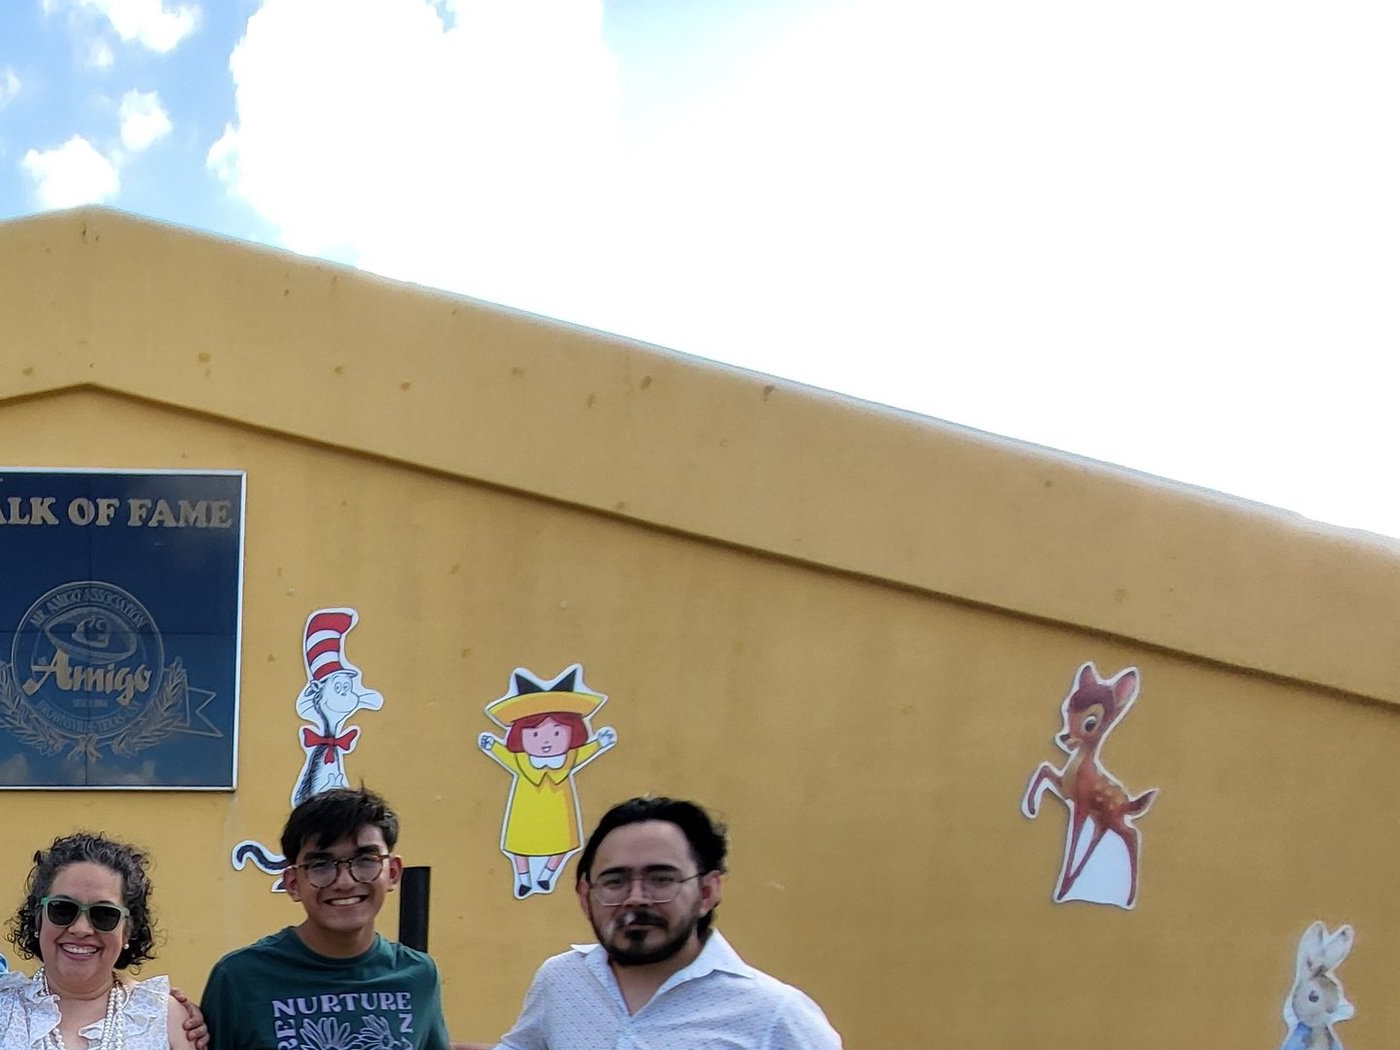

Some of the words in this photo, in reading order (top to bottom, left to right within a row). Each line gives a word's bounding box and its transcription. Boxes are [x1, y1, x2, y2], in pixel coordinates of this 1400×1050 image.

[67, 497, 120, 527] OF
[127, 498, 233, 529] FAME
[22, 648, 153, 706] Amigo
[272, 992, 413, 1018] NURTURE
